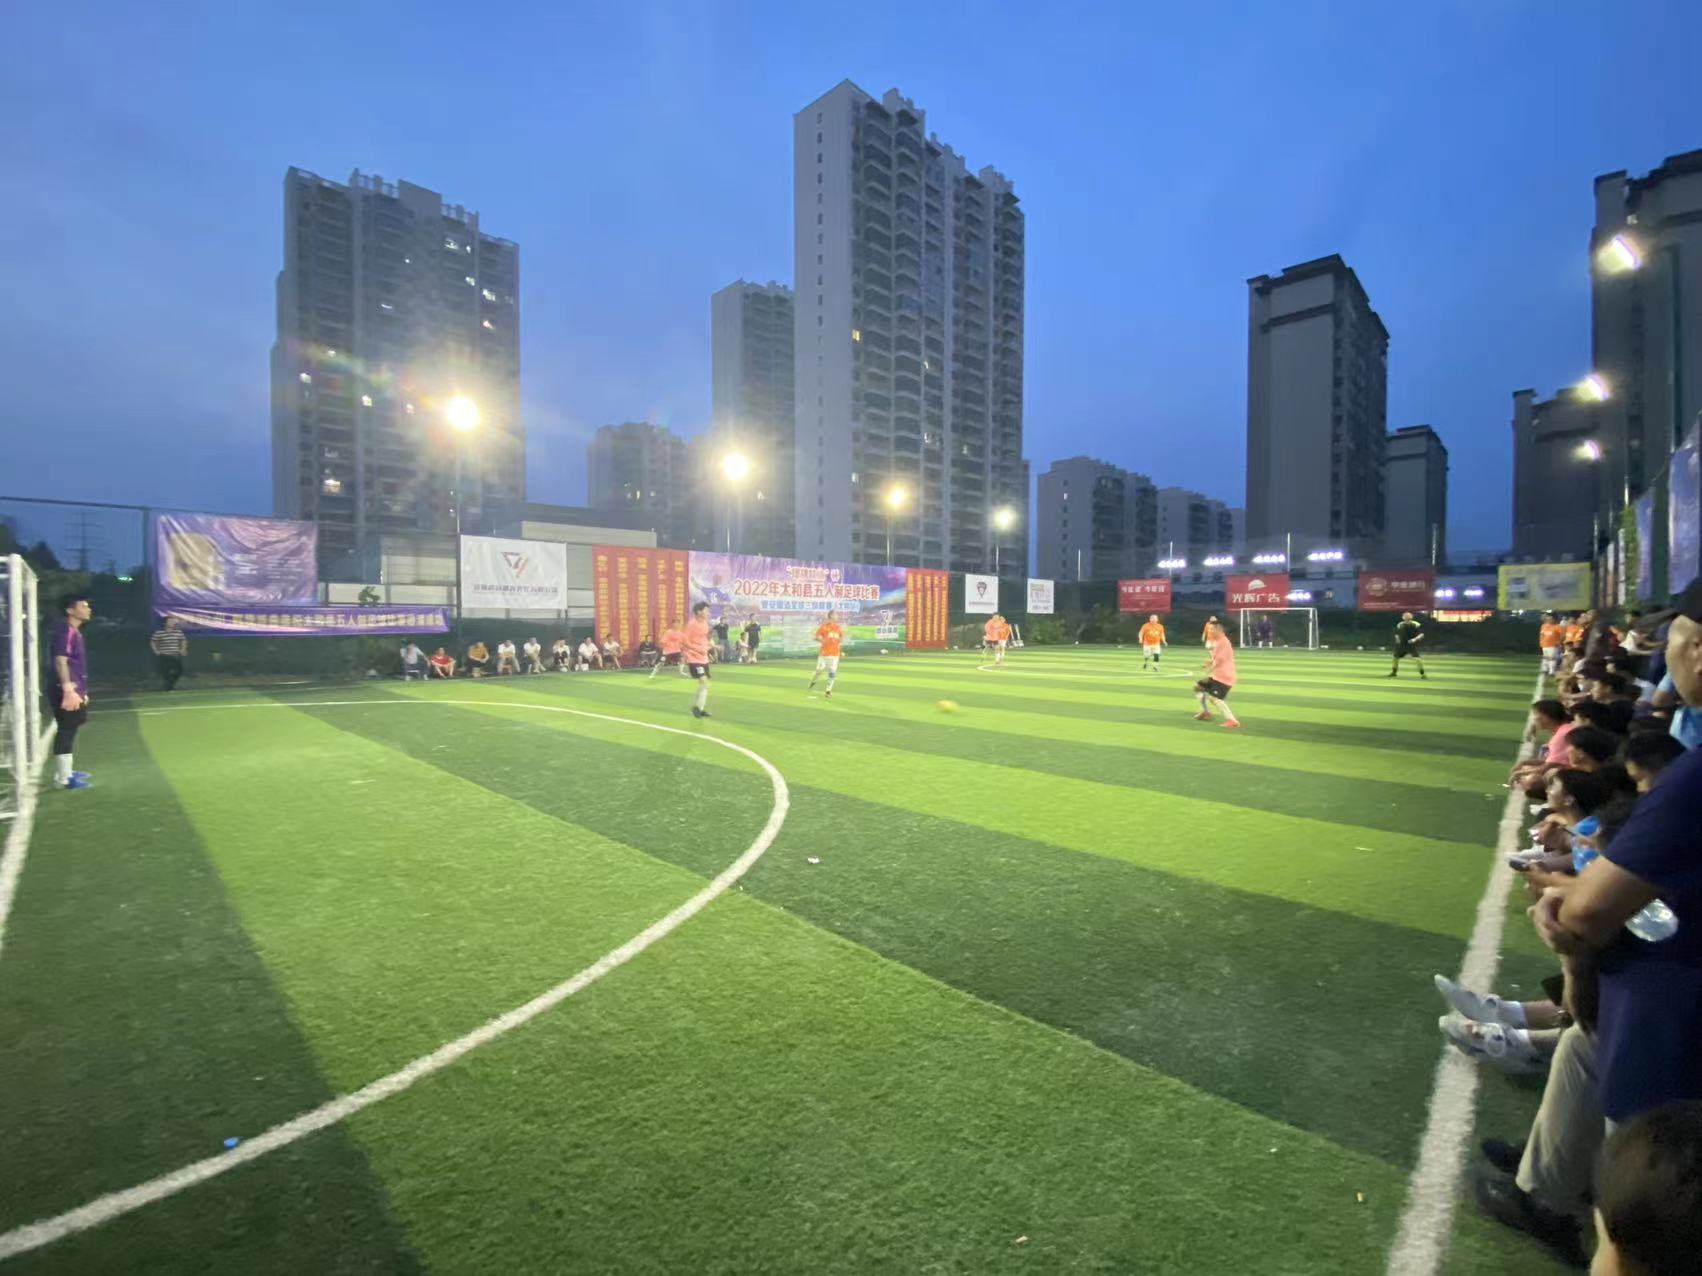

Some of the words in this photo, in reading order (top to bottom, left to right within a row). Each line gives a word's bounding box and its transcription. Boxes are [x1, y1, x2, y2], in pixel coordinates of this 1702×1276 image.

[734, 579, 880, 601] 2022年太和县五人制足球比赛
[1232, 592, 1281, 604] 光辉广告
